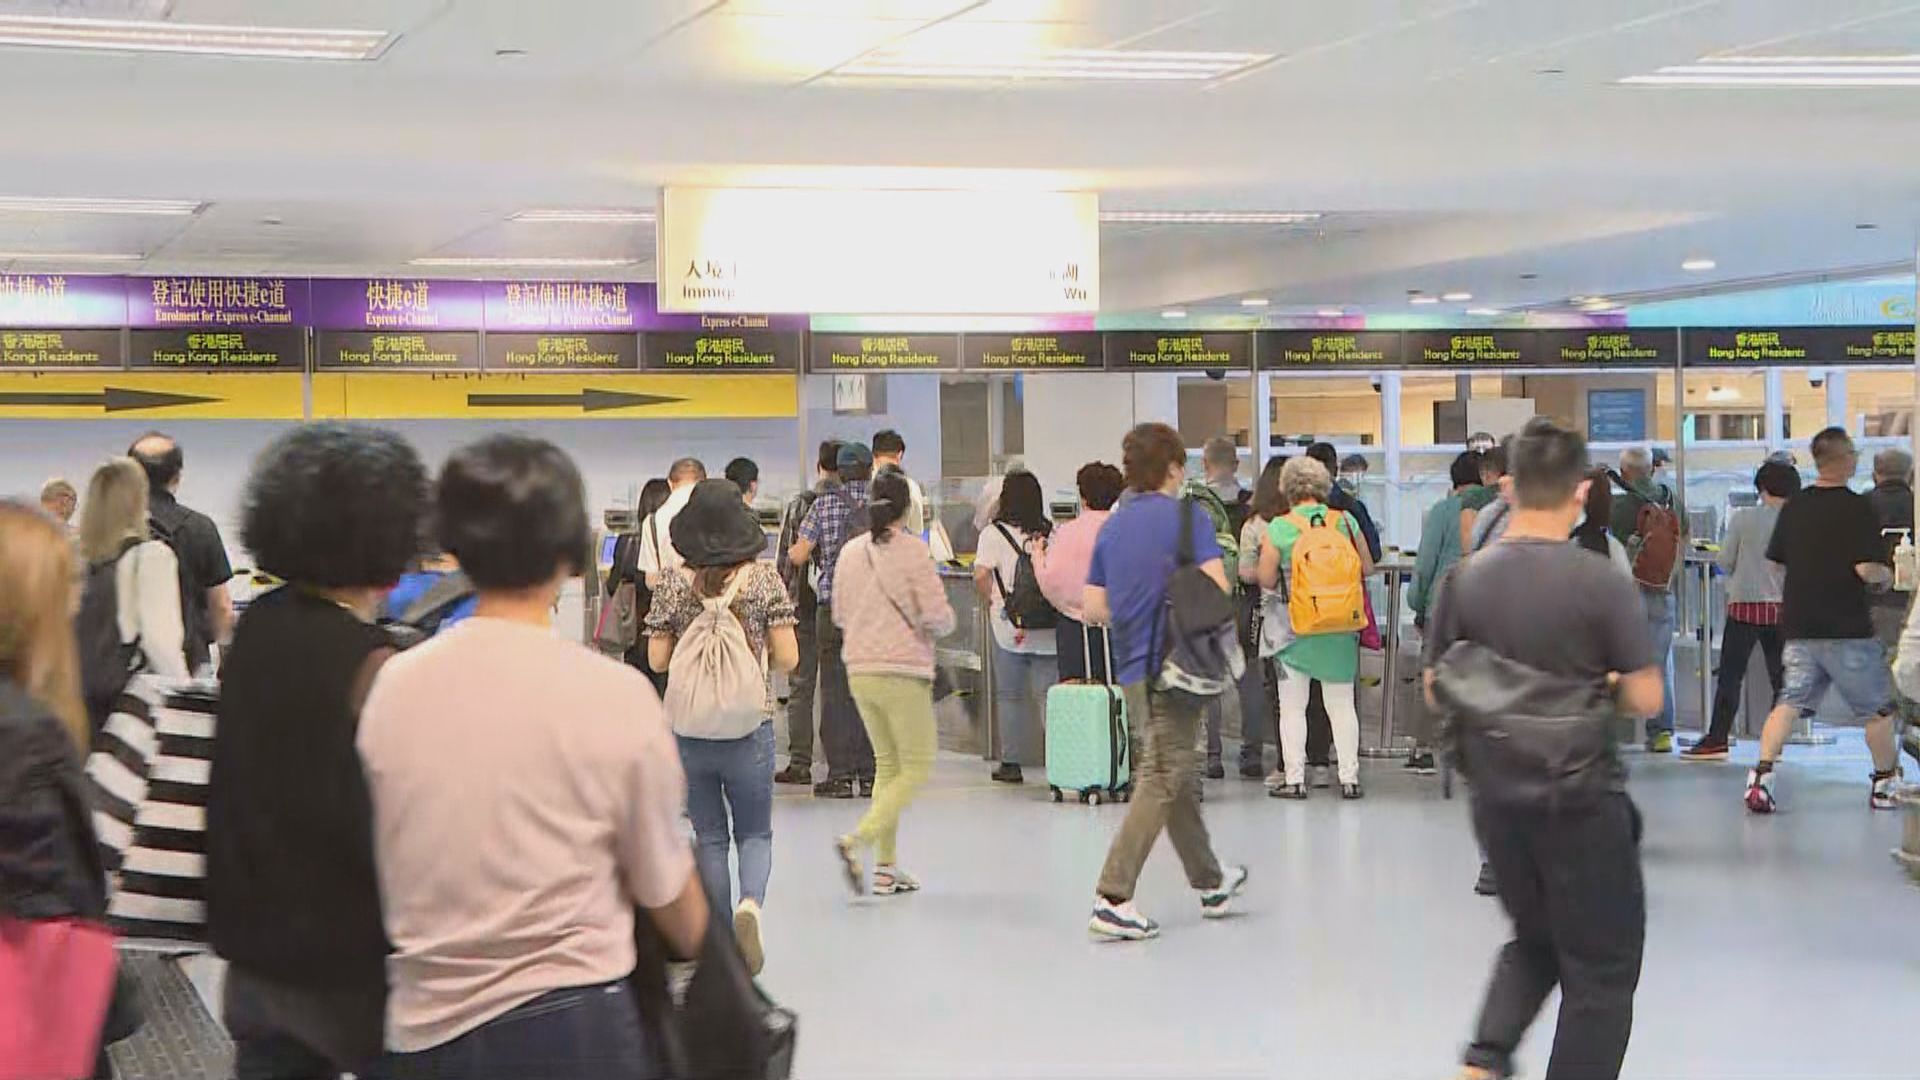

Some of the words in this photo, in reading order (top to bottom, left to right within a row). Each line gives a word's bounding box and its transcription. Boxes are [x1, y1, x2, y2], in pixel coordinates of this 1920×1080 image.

[152, 278, 286, 308] 登記使用快捷e道
[367, 280, 429, 311] 快捷e道
[155, 309, 199, 322] Enrolment
[201, 309, 214, 322] for
[216, 309, 248, 325] Express
[251, 310, 292, 323] e-Channel
[701, 315, 730, 331] Express
[732, 315, 769, 328] e-Channel
[2, 333, 63, 350] 香港居民
[188, 333, 243, 349] 香港居民
[372, 336, 425, 351] 香港居民
[538, 338, 589, 353] 香港居民
[696, 338, 745, 353] 香港居民
[861, 337, 909, 352] 香港居民
[1011, 337, 1058, 352] 香港居民
[1157, 337, 1203, 352] 香港居民
[1312, 336, 1356, 351] 香港居民
[1451, 336, 1495, 350] 香港居民
[1587, 335, 1631, 349] 香港居民
[1736, 332, 1780, 347] 香港居民
[4, 350, 36, 363] Kong
[39, 350, 99, 362] Residents
[153, 350, 185, 363] Hong
[188, 350, 218, 363] Kong
[221, 350, 278, 362] Residents
[340, 350, 370, 363] Hong
[373, 351, 401, 364] Kong
[404, 349, 457, 361] Residents
[506, 351, 535, 364] Hong
[538, 351, 565, 364] Kong
[567, 351, 619, 363] Residents
[666, 352, 694, 365] Hong
[696, 352, 723, 365] Kong
[725, 351, 775, 363] Residents
[983, 352, 1009, 365] Hong
[1011, 353, 1037, 365] Kong
[1039, 352, 1085, 364] Residents
[1129, 350, 1156, 363] Hong
[1158, 352, 1182, 363] Kong
[1184, 350, 1230, 361] Residents
[1284, 350, 1310, 362] Hong
[1312, 351, 1336, 362] Kong
[1338, 349, 1383, 360] Residents
[1424, 348, 1449, 361] Hong
[1452, 350, 1475, 361] Kong
[1477, 348, 1520, 359] Residents
[1561, 348, 1586, 360] Hong
[1588, 349, 1612, 360] Kong
[1613, 347, 1657, 358] Residents
[1709, 346, 1735, 360] Hong
[1736, 347, 1760, 360] Kong
[1761, 346, 1805, 358] Residents
[1847, 344, 1872, 358] Hong
[1873, 345, 1897, 358] Kong
[832, 352, 859, 366] Hong
[861, 353, 887, 366] Kong
[889, 352, 939, 364] Residents
